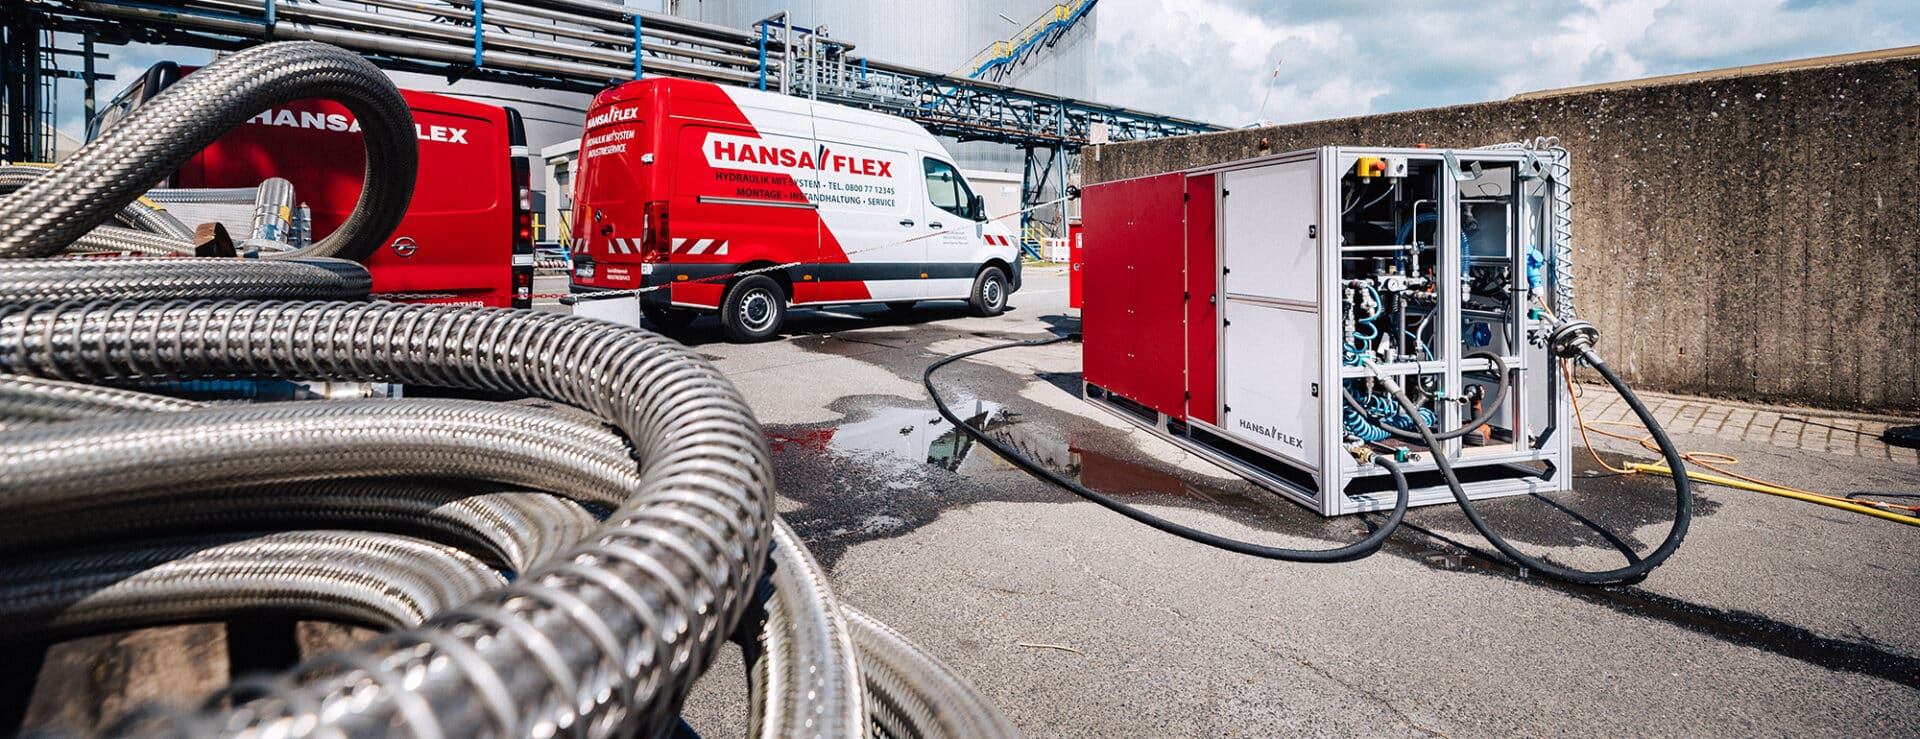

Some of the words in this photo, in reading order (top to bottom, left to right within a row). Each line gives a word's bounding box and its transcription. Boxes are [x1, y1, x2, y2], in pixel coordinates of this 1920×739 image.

[587, 113, 609, 129] HANSA
[613, 107, 638, 121] FLEX
[415, 124, 468, 144] LEX
[714, 141, 815, 170] HANSA
[833, 155, 892, 178] FLEX
[715, 171, 770, 185] HYDRAULIK
[771, 175, 788, 185] MIT
[789, 177, 821, 189] SYSTEM
[828, 182, 844, 191] TEL.
[845, 184, 864, 192] 0800
[864, 185, 873, 193] 77
[874, 186, 896, 195] 12345
[736, 188, 782, 199] MONTAGE
[789, 192, 861, 205] INSTANDHALTUNG
[868, 198, 896, 207] SERVICE
[1239, 419, 1271, 438] HANSA
[1277, 432, 1303, 449] FLEX
